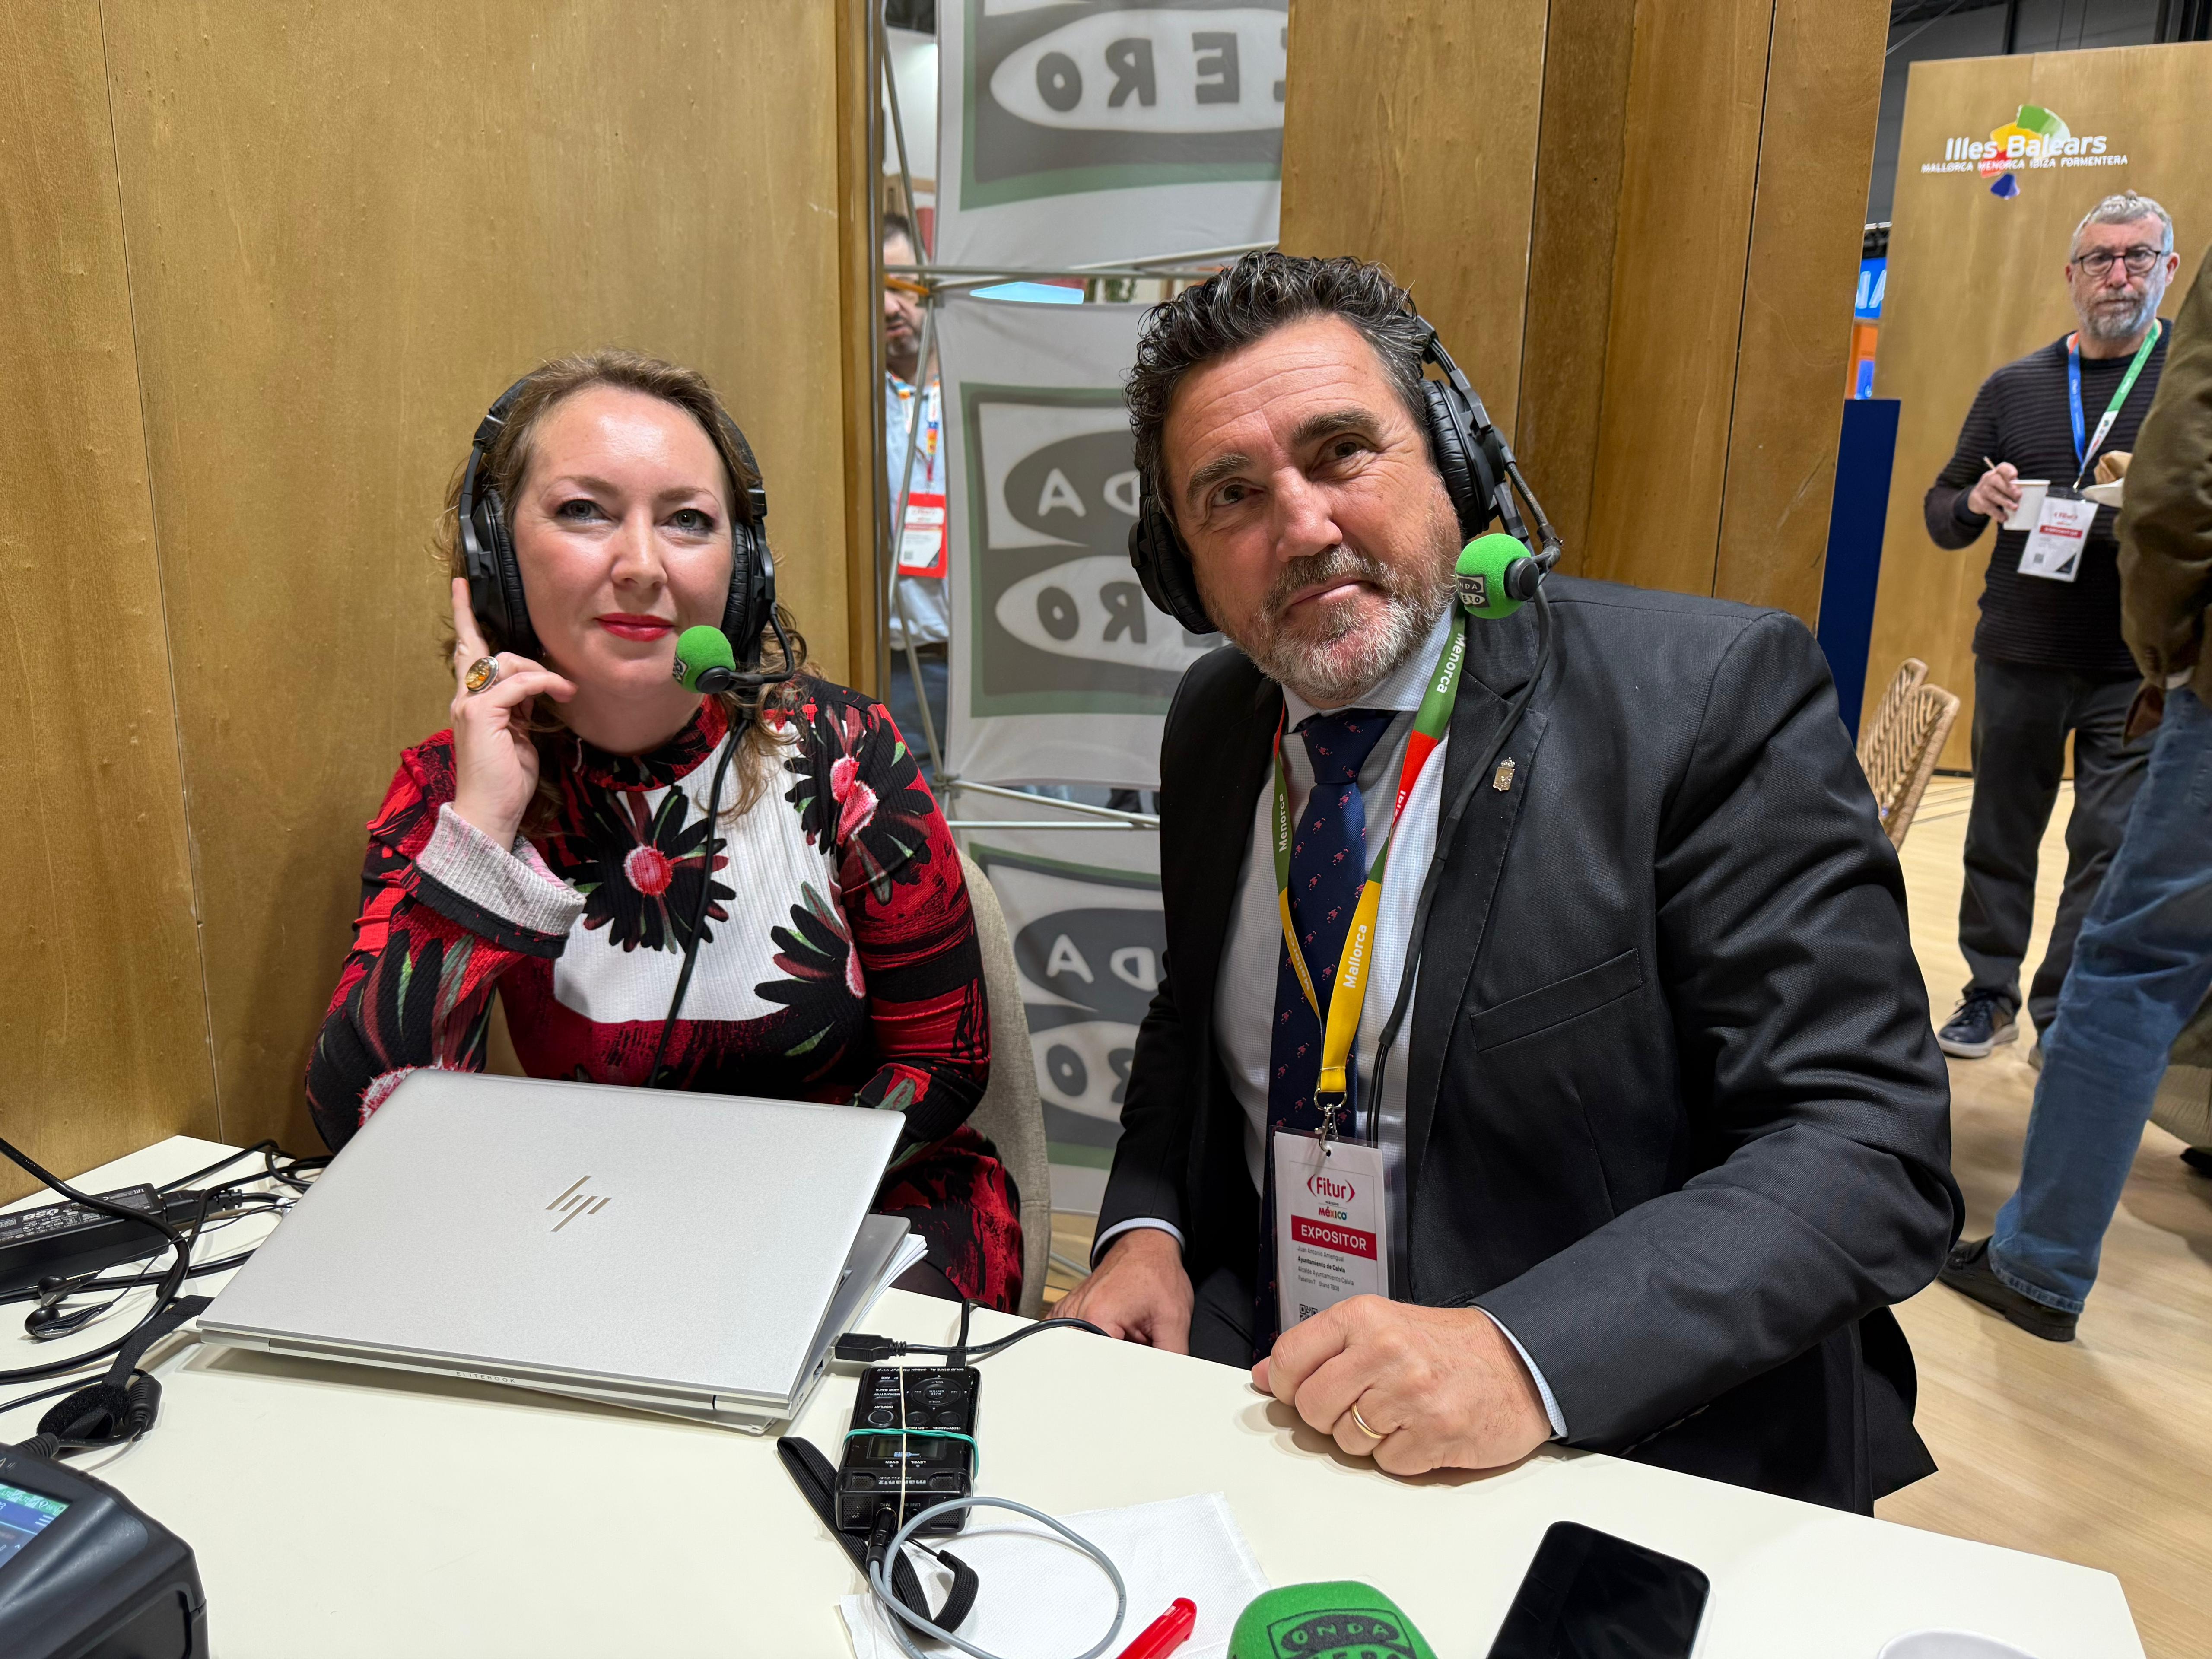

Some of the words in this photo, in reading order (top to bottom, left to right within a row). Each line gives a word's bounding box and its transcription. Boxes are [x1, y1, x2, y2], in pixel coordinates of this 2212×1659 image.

[1945, 137, 1998, 161] Illes
[2006, 136, 2107, 157] Balears
[1921, 162, 1973, 173] MALLORCA
[1977, 159, 2024, 172] MENORCA
[2030, 157, 2056, 168] IBIZA
[2060, 155, 2128, 168] FORMENTERA
[1462, 594, 1480, 603] ERO
[1436, 632, 1467, 693] Menorca
[1279, 793, 1288, 852] Menorca
[1343, 925, 1367, 988] Mallorca
[1301, 1224, 1367, 1251] EXPOSITOR
[456, 1371, 515, 1383] ELITEBOOK
[1291, 1623, 1389, 1645] ONDA
